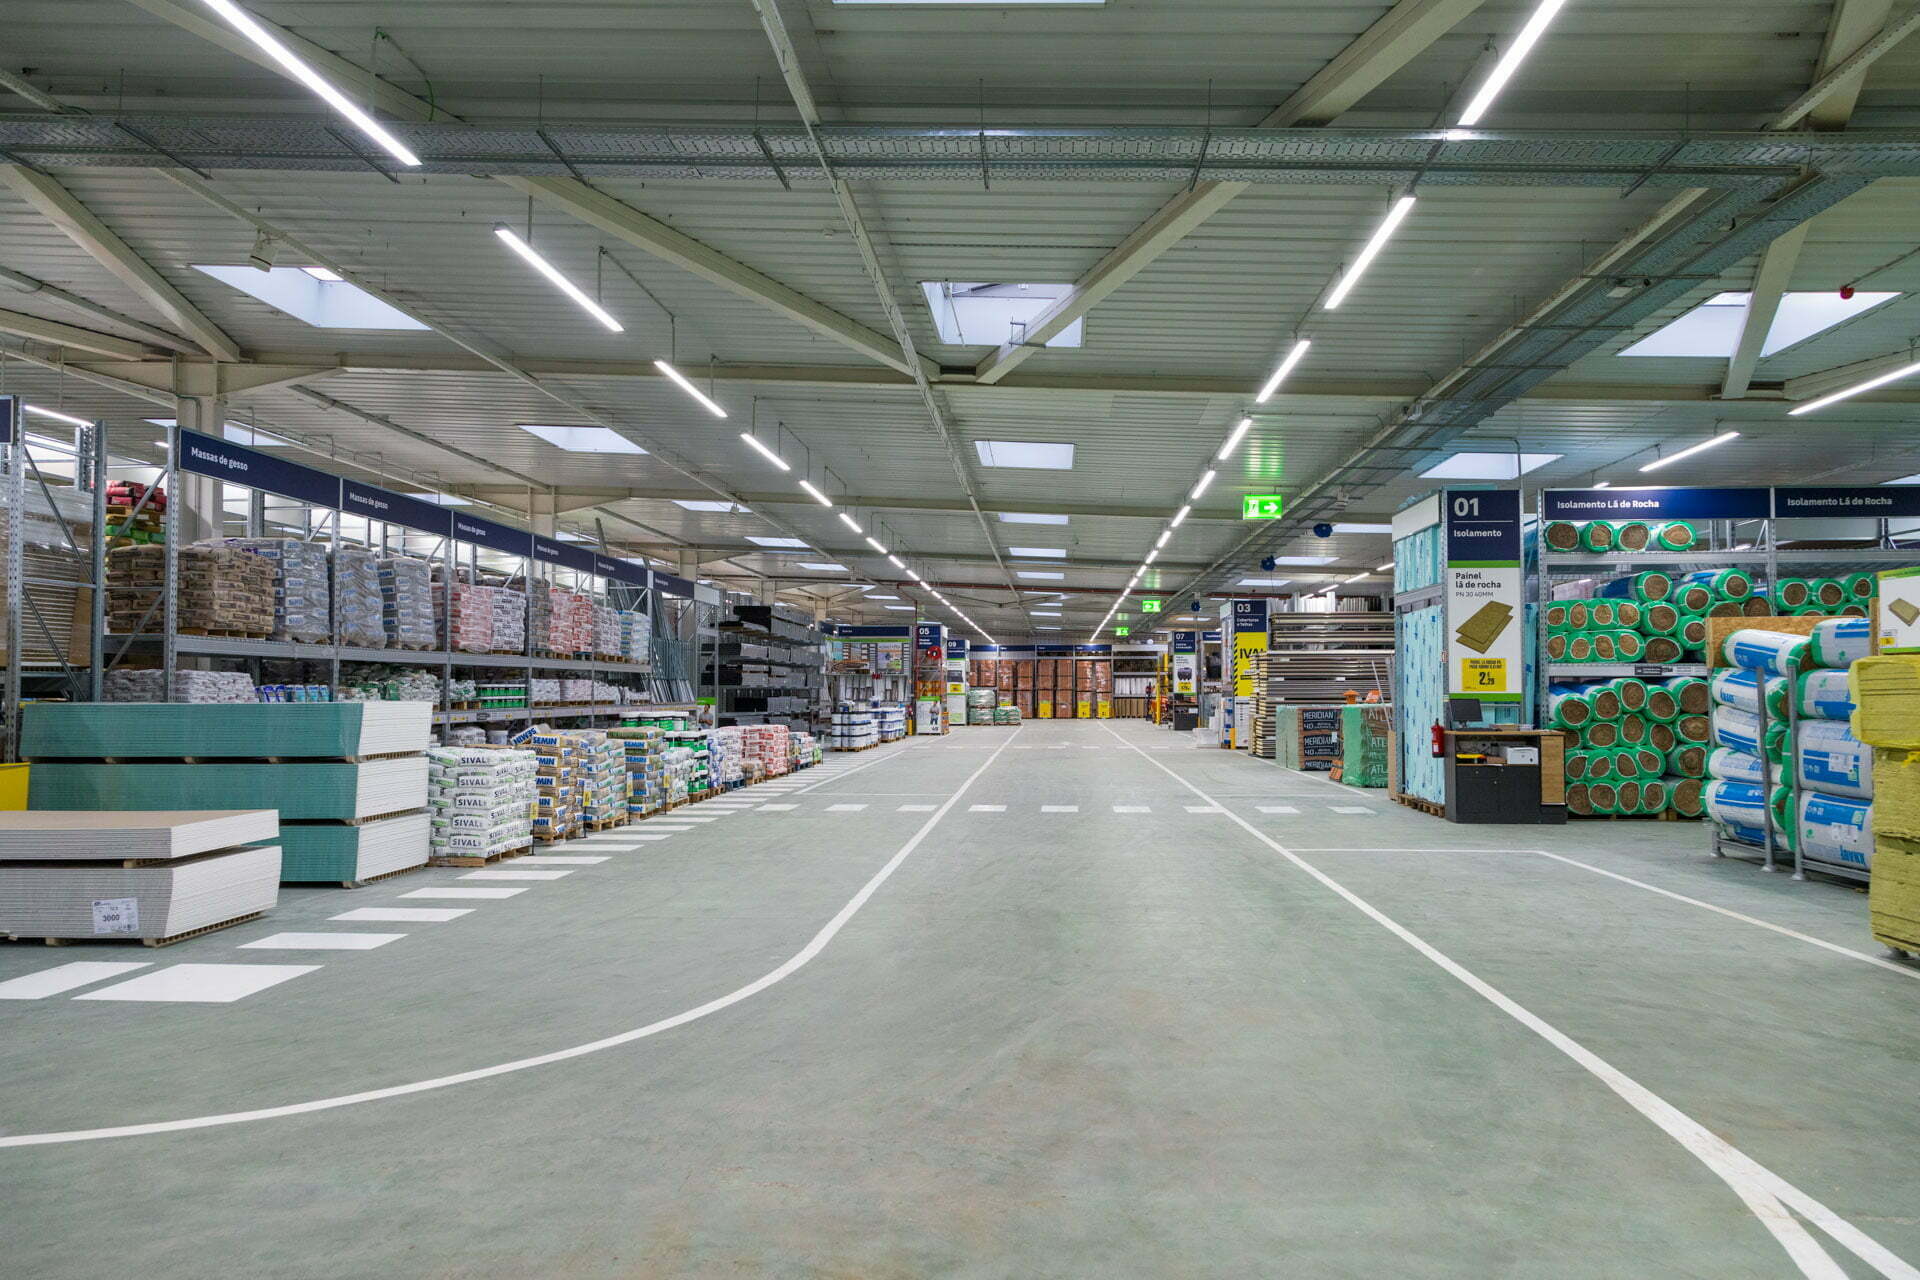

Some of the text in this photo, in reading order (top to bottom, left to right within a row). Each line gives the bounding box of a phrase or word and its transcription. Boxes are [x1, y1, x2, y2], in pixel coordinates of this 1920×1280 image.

[191, 446, 248, 471] Massas de gesso
[1557, 500, 1606, 509] Isolamento
[1620, 499, 1631, 508] de
[1632, 499, 1660, 508] Rocha
[1787, 497, 1838, 506] Isolamento
[1852, 497, 1863, 505] de
[1864, 496, 1893, 505] Rocha
[1454, 497, 1479, 517] 01
[1453, 528, 1502, 537] Isolamento
[1455, 572, 1482, 580] Painel
[1465, 580, 1476, 589] de
[1477, 580, 1502, 589] rocha
[1237, 603, 1251, 613] 03
[1303, 711, 1334, 720] MERIDIAN
[532, 736, 558, 746] SEMIN
[461, 756, 487, 765] SIVAL
[536, 757, 555, 766] MIN
[460, 778, 486, 786] SIVAL
[536, 778, 553, 788] MIN
[457, 799, 484, 807] SIVAL
[454, 819, 480, 828] SIVAL
[452, 838, 477, 847] SIVAL
